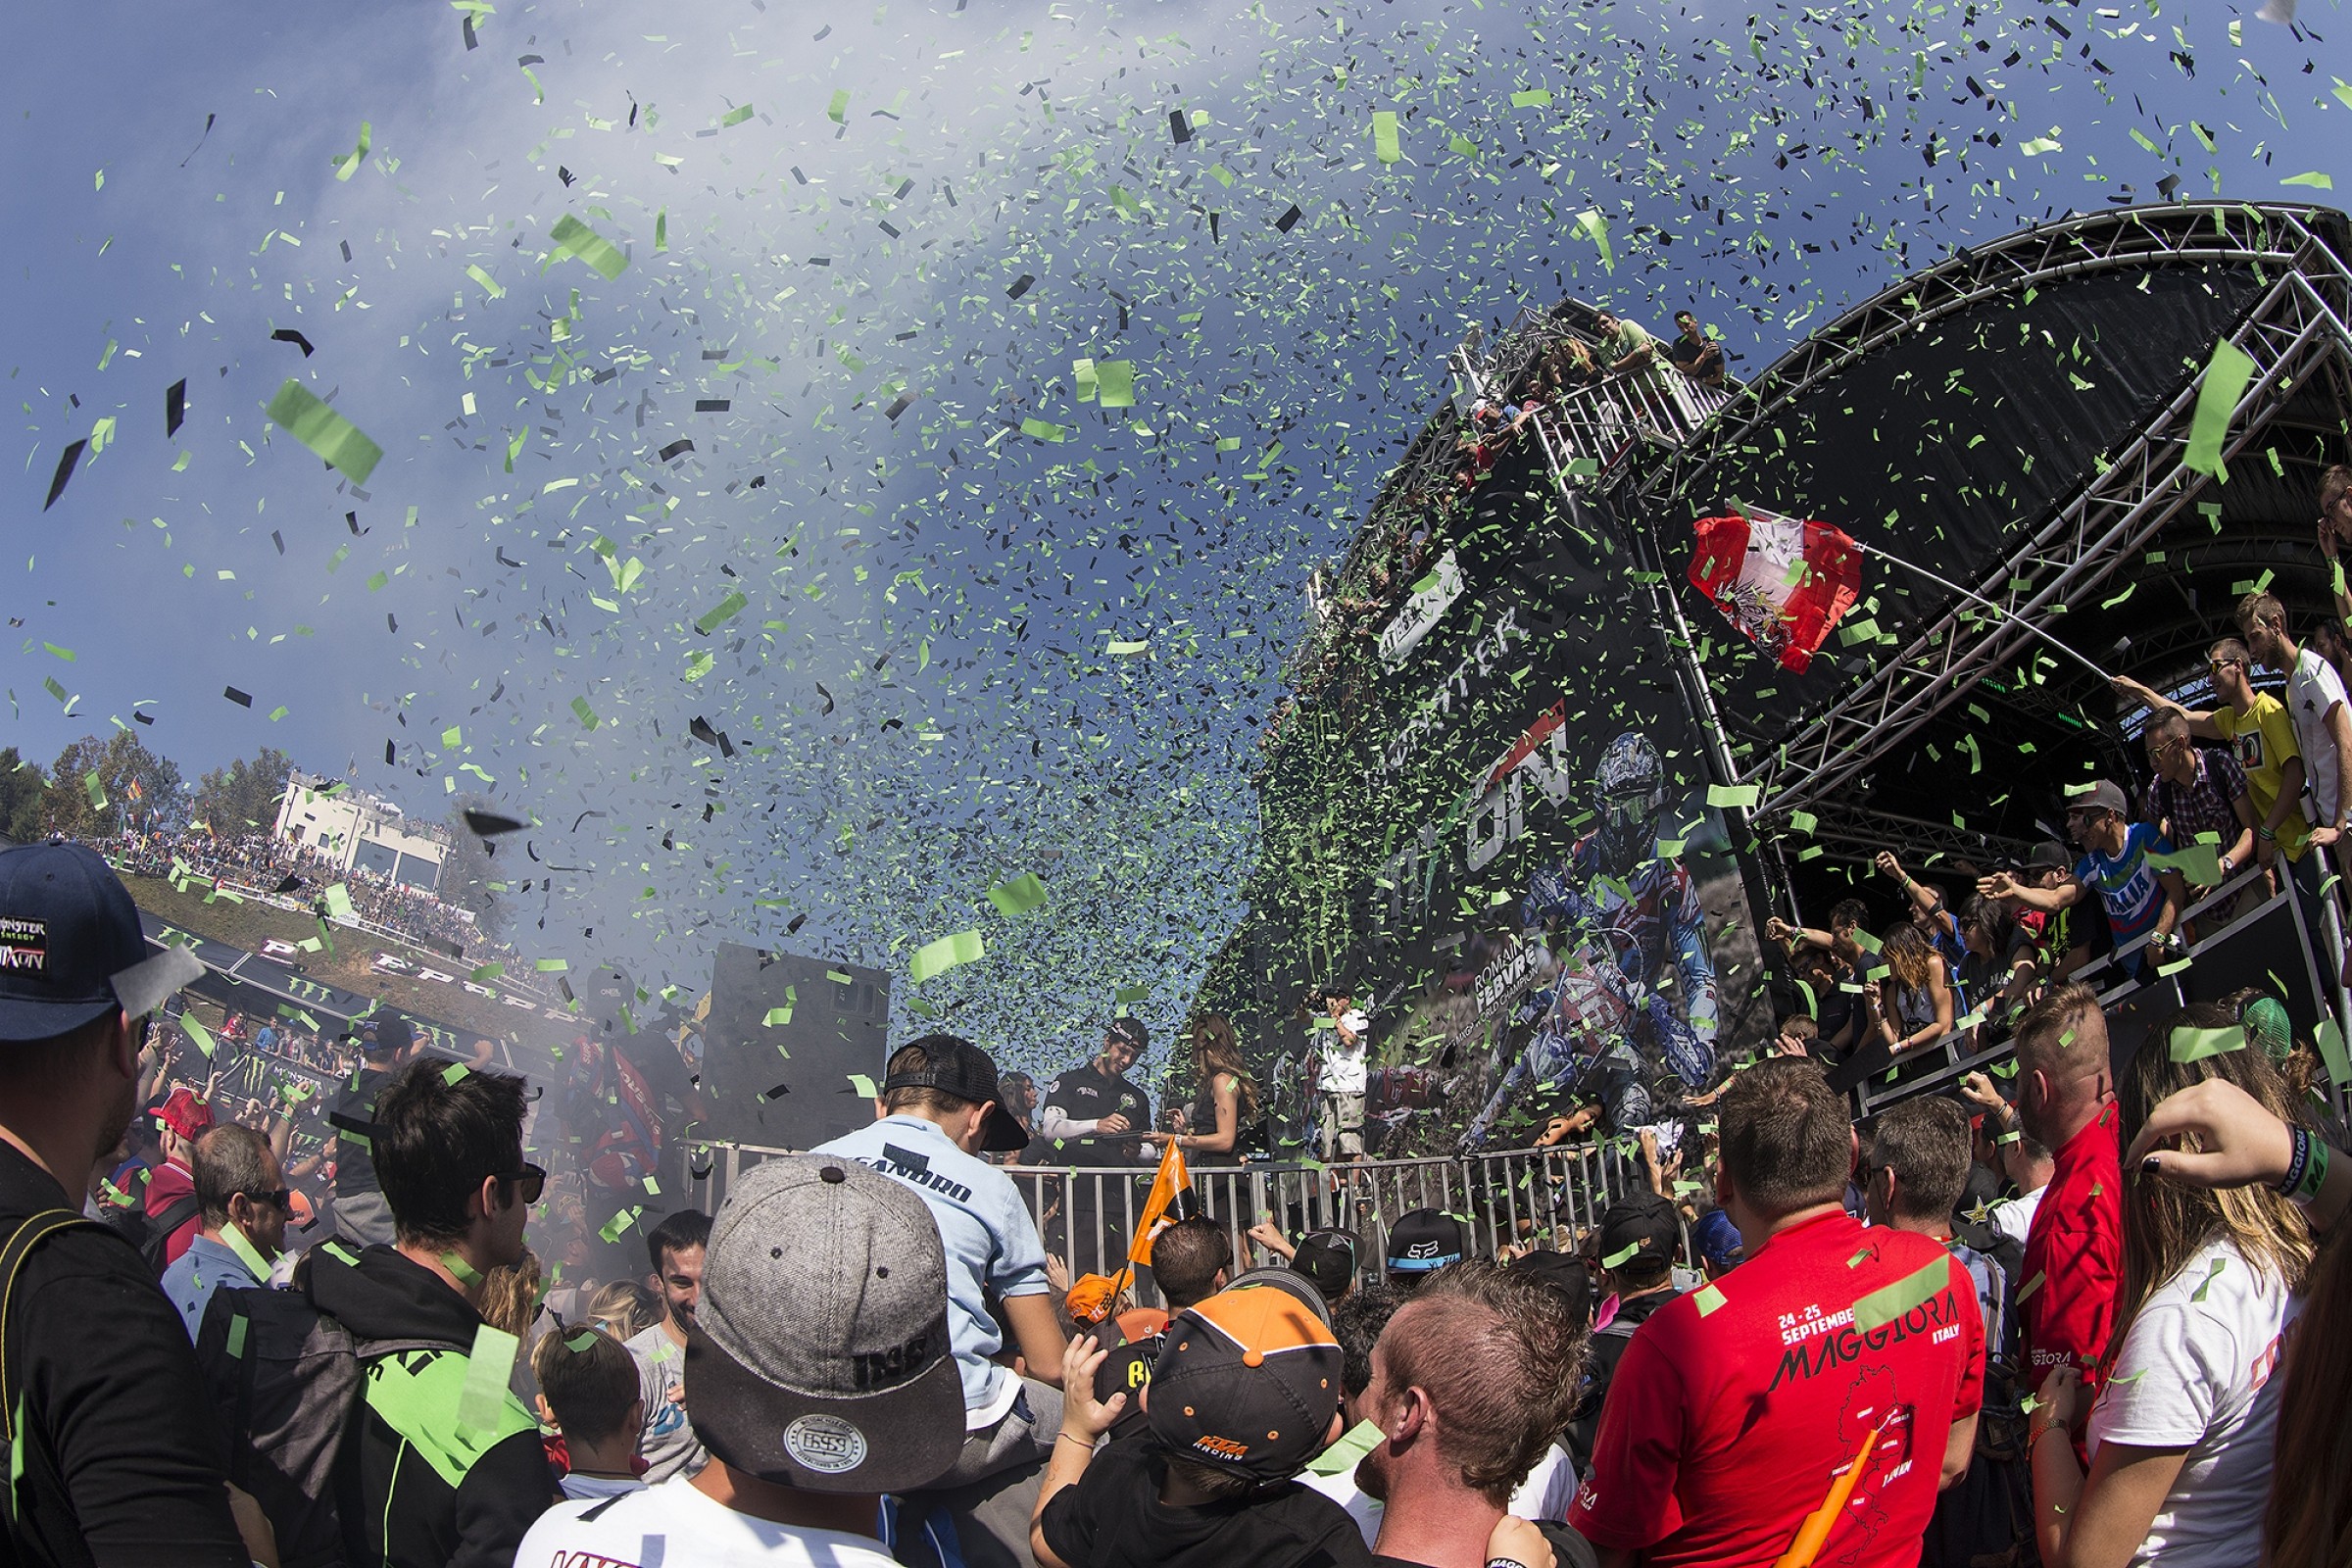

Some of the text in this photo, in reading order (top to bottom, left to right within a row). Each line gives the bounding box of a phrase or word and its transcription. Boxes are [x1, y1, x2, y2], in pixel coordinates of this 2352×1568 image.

[0, 916, 45, 935] ONSTER
[1474, 934, 1525, 993] ROMAIN
[1475, 944, 1539, 1013] FEBVRE
[1499, 966, 1540, 1006] CHAMPION
[274, 1065, 322, 1091] MNSTER
[1778, 1312, 1796, 1330] 24
[1804, 1303, 1822, 1321] 25
[1781, 1307, 1857, 1346] SEPTEMBE
[1767, 1291, 1959, 1393] MAGGIORA
[1932, 1323, 1960, 1345] ITALY
[1192, 1442, 1245, 1461] RACING
[1196, 1435, 1250, 1456] KTM
